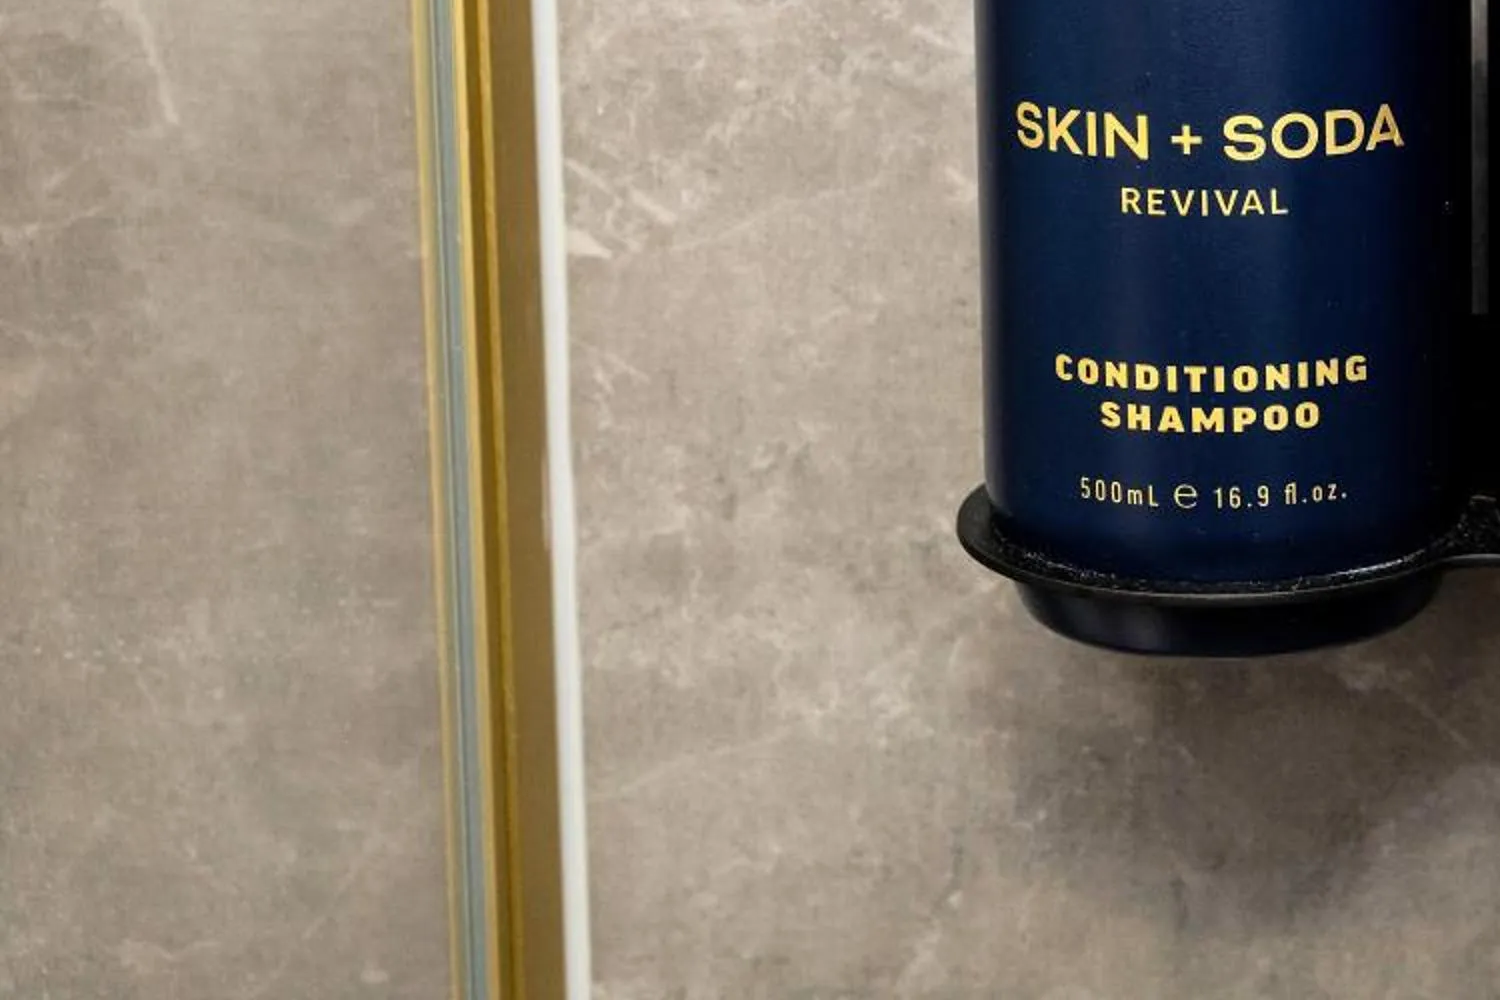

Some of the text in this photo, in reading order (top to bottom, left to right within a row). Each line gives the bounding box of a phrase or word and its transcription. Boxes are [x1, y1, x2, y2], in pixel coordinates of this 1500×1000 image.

[1015, 101, 1405, 162] SKIN + SODA
[1120, 187, 1289, 217] REVIVAL
[1055, 353, 1368, 393] CONDITIONING
[1100, 401, 1320, 434] SHAMPOO
[1080, 476, 1159, 508] 500mL
[1214, 485, 1270, 510] 16.9
